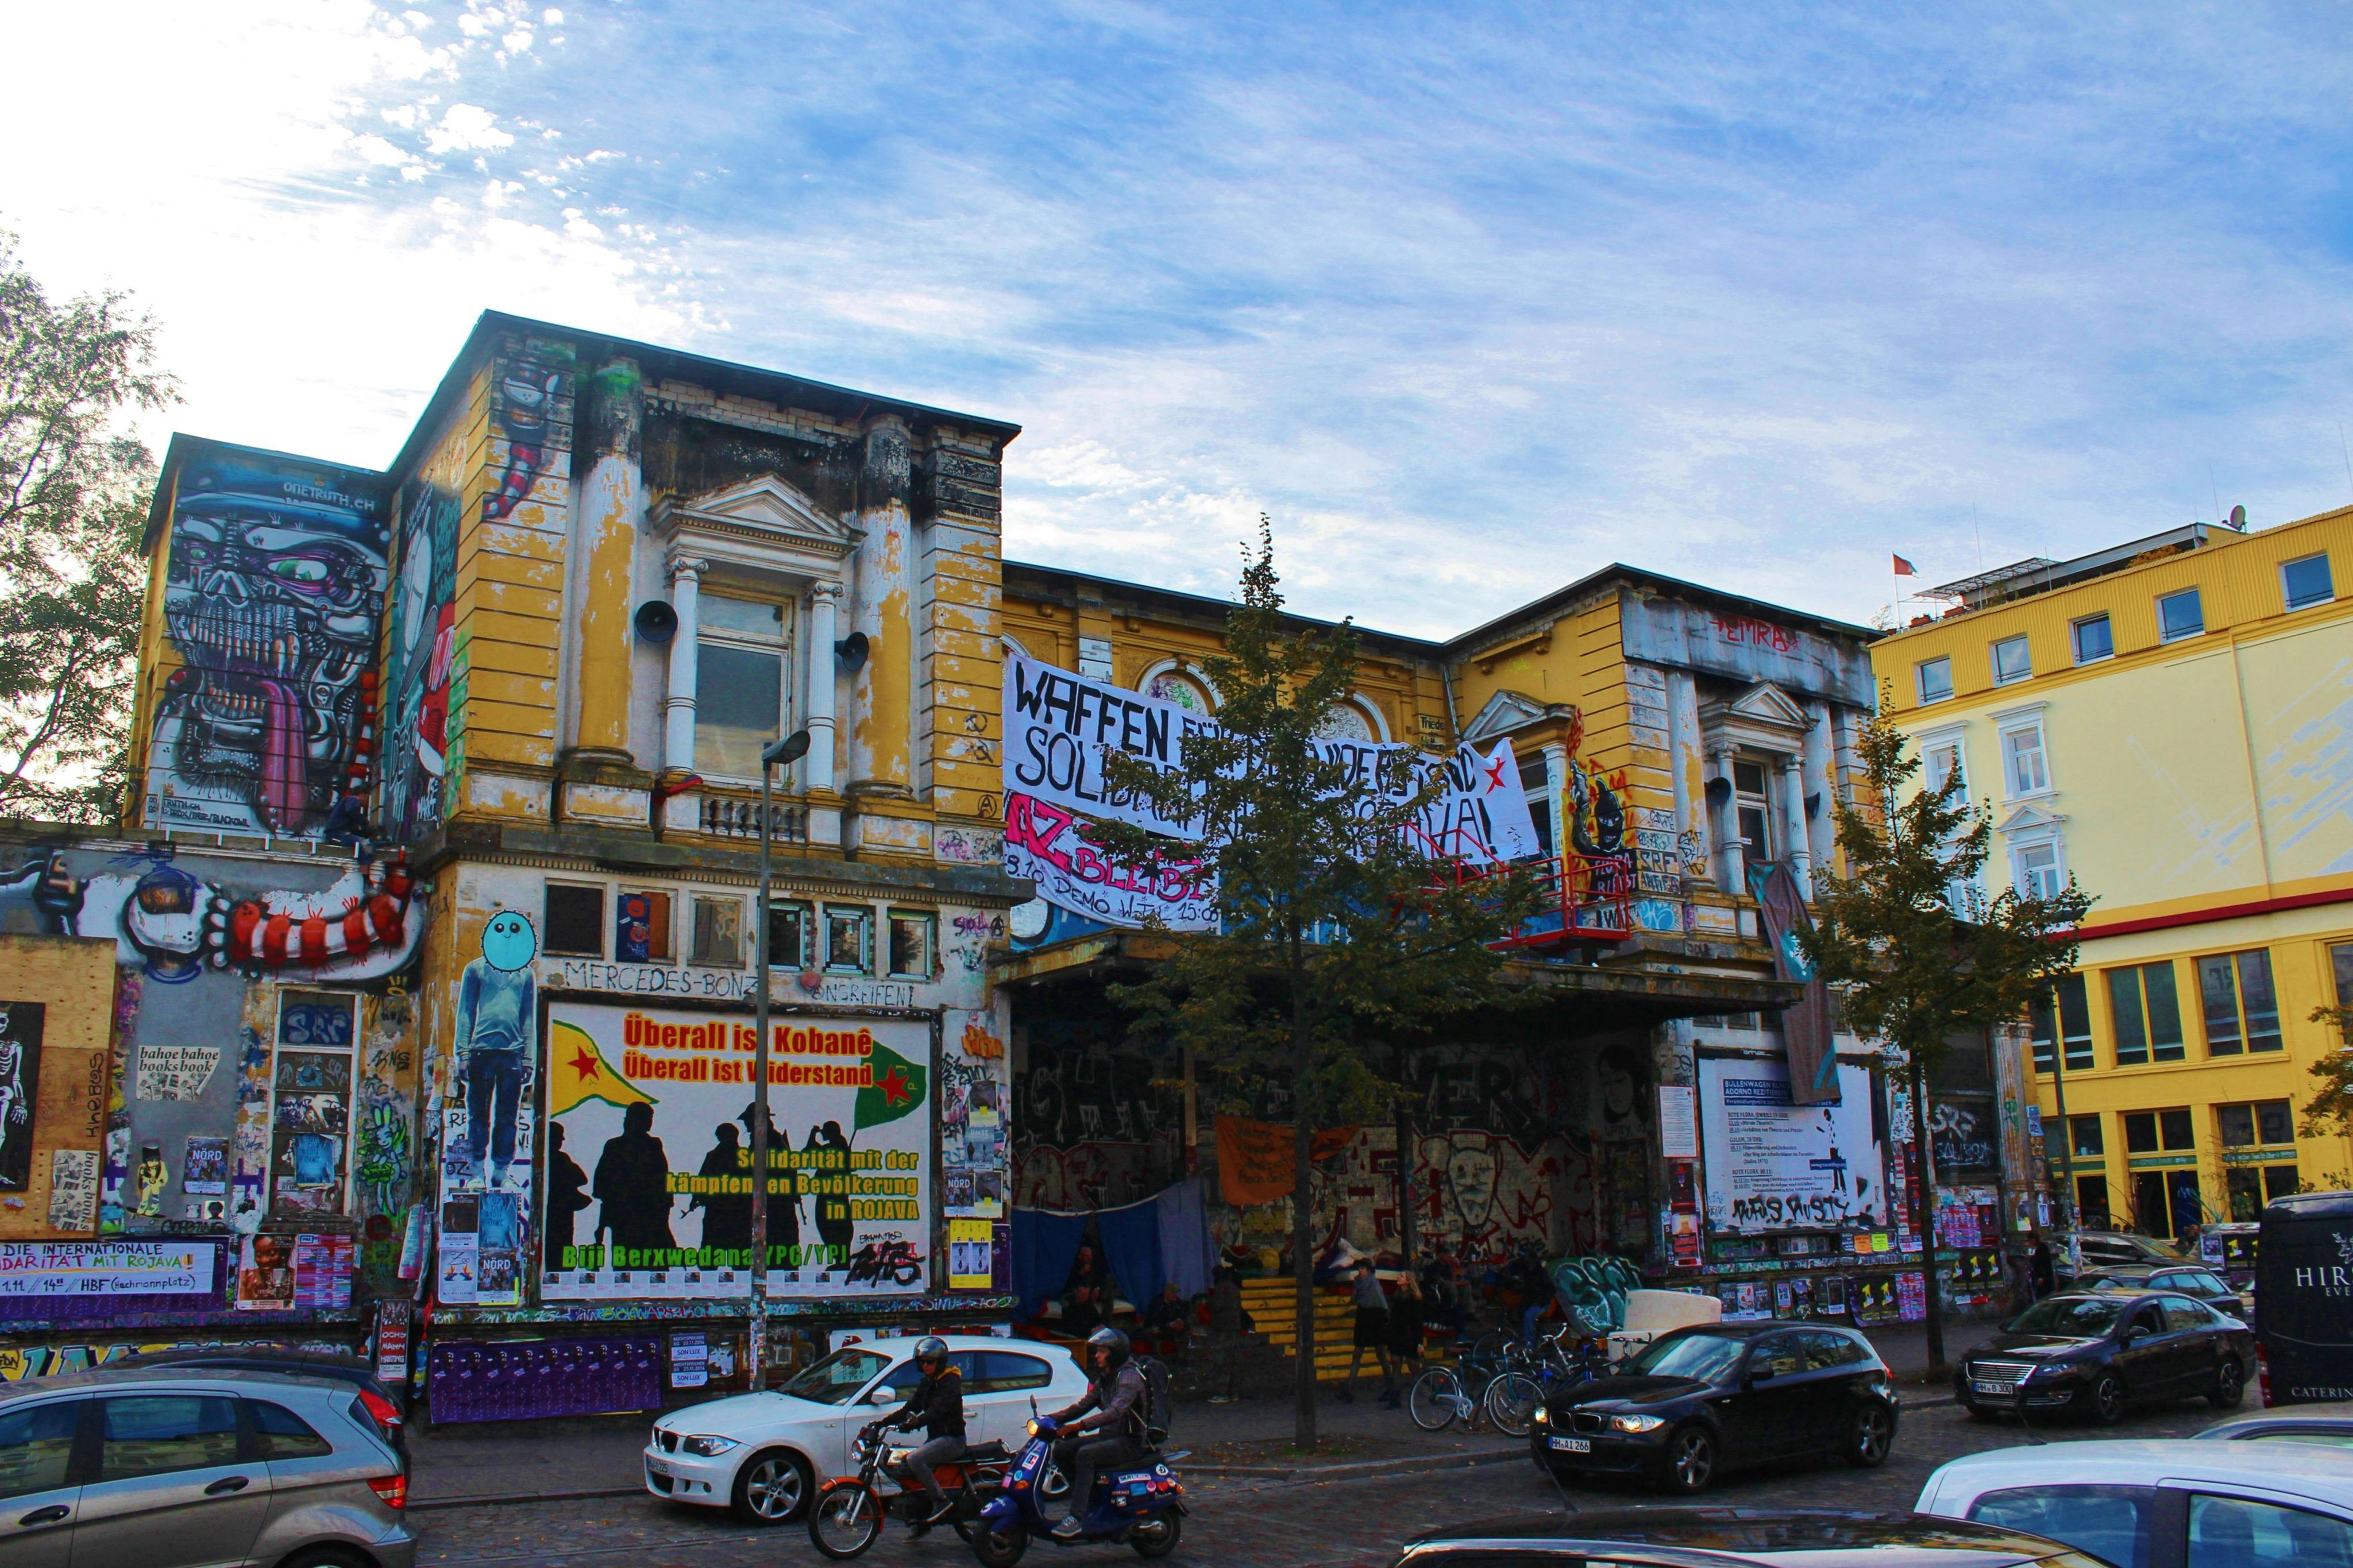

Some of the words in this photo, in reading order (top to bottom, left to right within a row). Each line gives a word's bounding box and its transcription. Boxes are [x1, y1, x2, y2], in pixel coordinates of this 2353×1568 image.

[1015, 660, 1170, 763] WAFFEN
[1005, 790, 1073, 874] AZ
[1054, 875, 1110, 914] DEMO
[624, 1013, 727, 1051] Überall
[733, 1023, 769, 1052] is
[774, 1026, 873, 1057] Kobanê
[140, 1046, 179, 1060] bahoe
[182, 1047, 219, 1060] bahoe
[139, 1060, 179, 1072] books
[180, 1061, 213, 1072] book
[624, 1049, 708, 1082] Überall
[712, 1057, 744, 1083] ist
[192, 1148, 222, 1161] NÖRD
[851, 1150, 882, 1169] mit
[886, 1150, 919, 1171] der
[82, 1152, 98, 1190] books
[666, 1172, 790, 1195] kämpfenen
[796, 1175, 919, 1197] Bevölkerung
[948, 1177, 971, 1188] NÖRD
[80, 1192, 95, 1231] books
[826, 1200, 846, 1220] in
[850, 1199, 920, 1221] ROJAVA
[3, 1244, 33, 1256] DIE
[43, 1243, 164, 1256] INTERNATIONALE
[562, 1245, 604, 1270] Biji
[483, 1257, 511, 1270] NÖRD
[81, 1279, 110, 1292] HBF
[111, 1274, 196, 1292] (Hachmannplatz)
[2296, 1266, 2353, 1287] HIR
